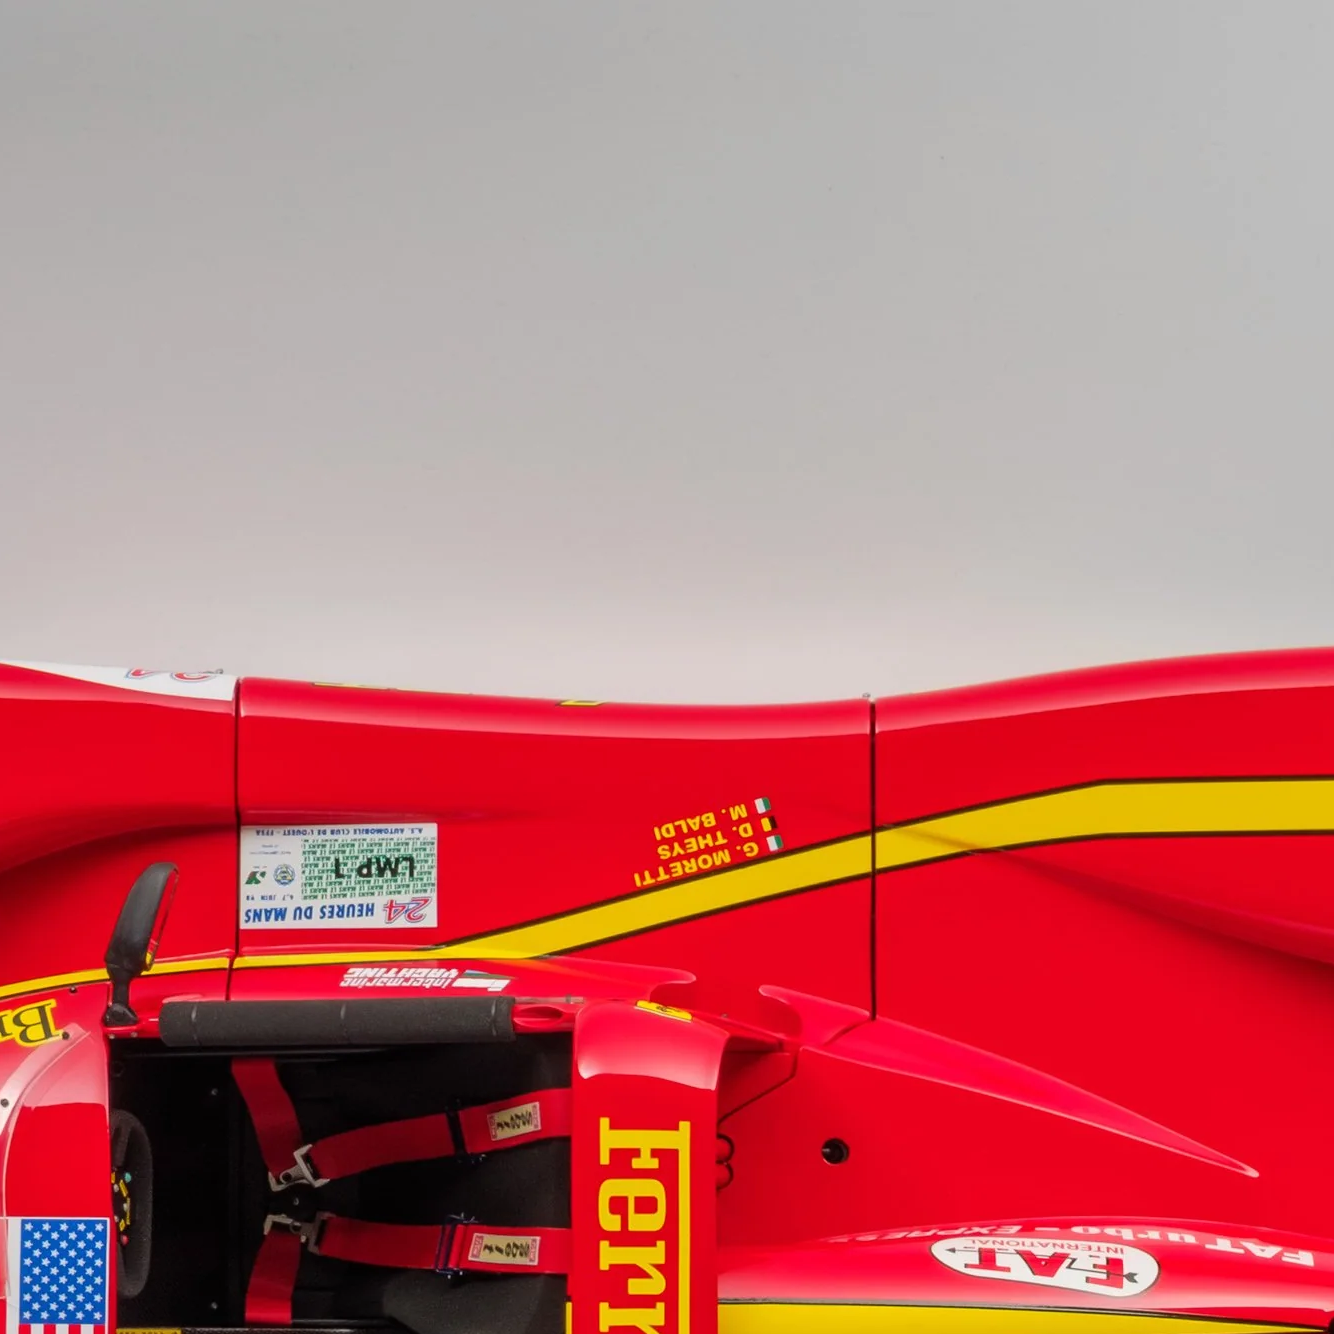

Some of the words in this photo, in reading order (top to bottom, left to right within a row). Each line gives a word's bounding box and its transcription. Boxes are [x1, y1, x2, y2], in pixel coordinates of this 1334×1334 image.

[721, 804, 748, 820] M.
[653, 812, 716, 840] BALDI
[732, 822, 753, 838] D.
[657, 831, 728, 859] THEYS
[736, 842, 759, 858] G.
[334, 857, 345, 879] 1
[355, 856, 415, 879] LMP
[634, 849, 731, 887] MORETTI
[244, 908, 287, 923] MANS
[293, 906, 313, 921] DU
[320, 903, 374, 919] HEURES
[383, 897, 432, 924] 24
[344, 968, 458, 978] YACHTING
[339, 978, 451, 989] intermarine
[963, 1239, 1124, 1255] INTERNATIONAL
